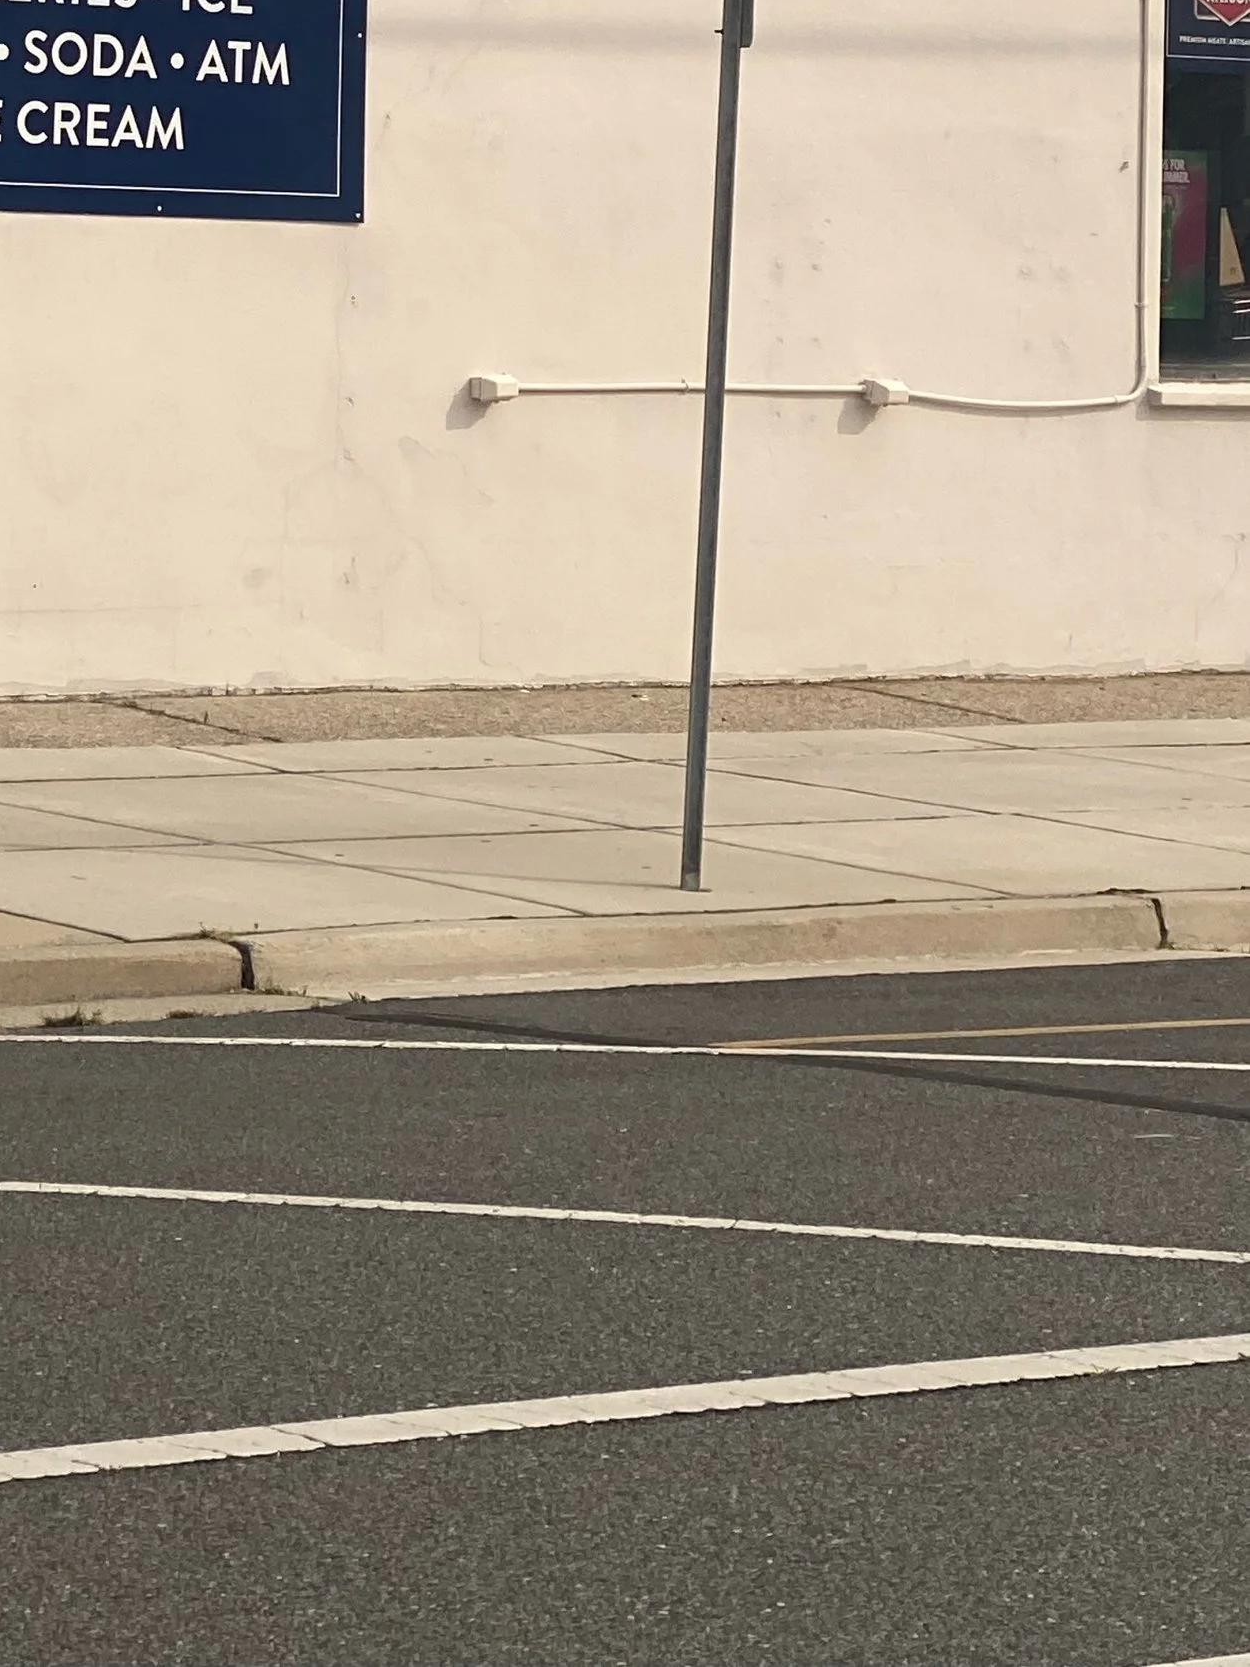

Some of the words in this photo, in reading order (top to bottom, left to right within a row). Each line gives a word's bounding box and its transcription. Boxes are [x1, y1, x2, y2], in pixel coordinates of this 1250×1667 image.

[24, 31, 158, 79] SODA
[195, 40, 291, 86] ATM
[16, 101, 184, 151] CREAM
